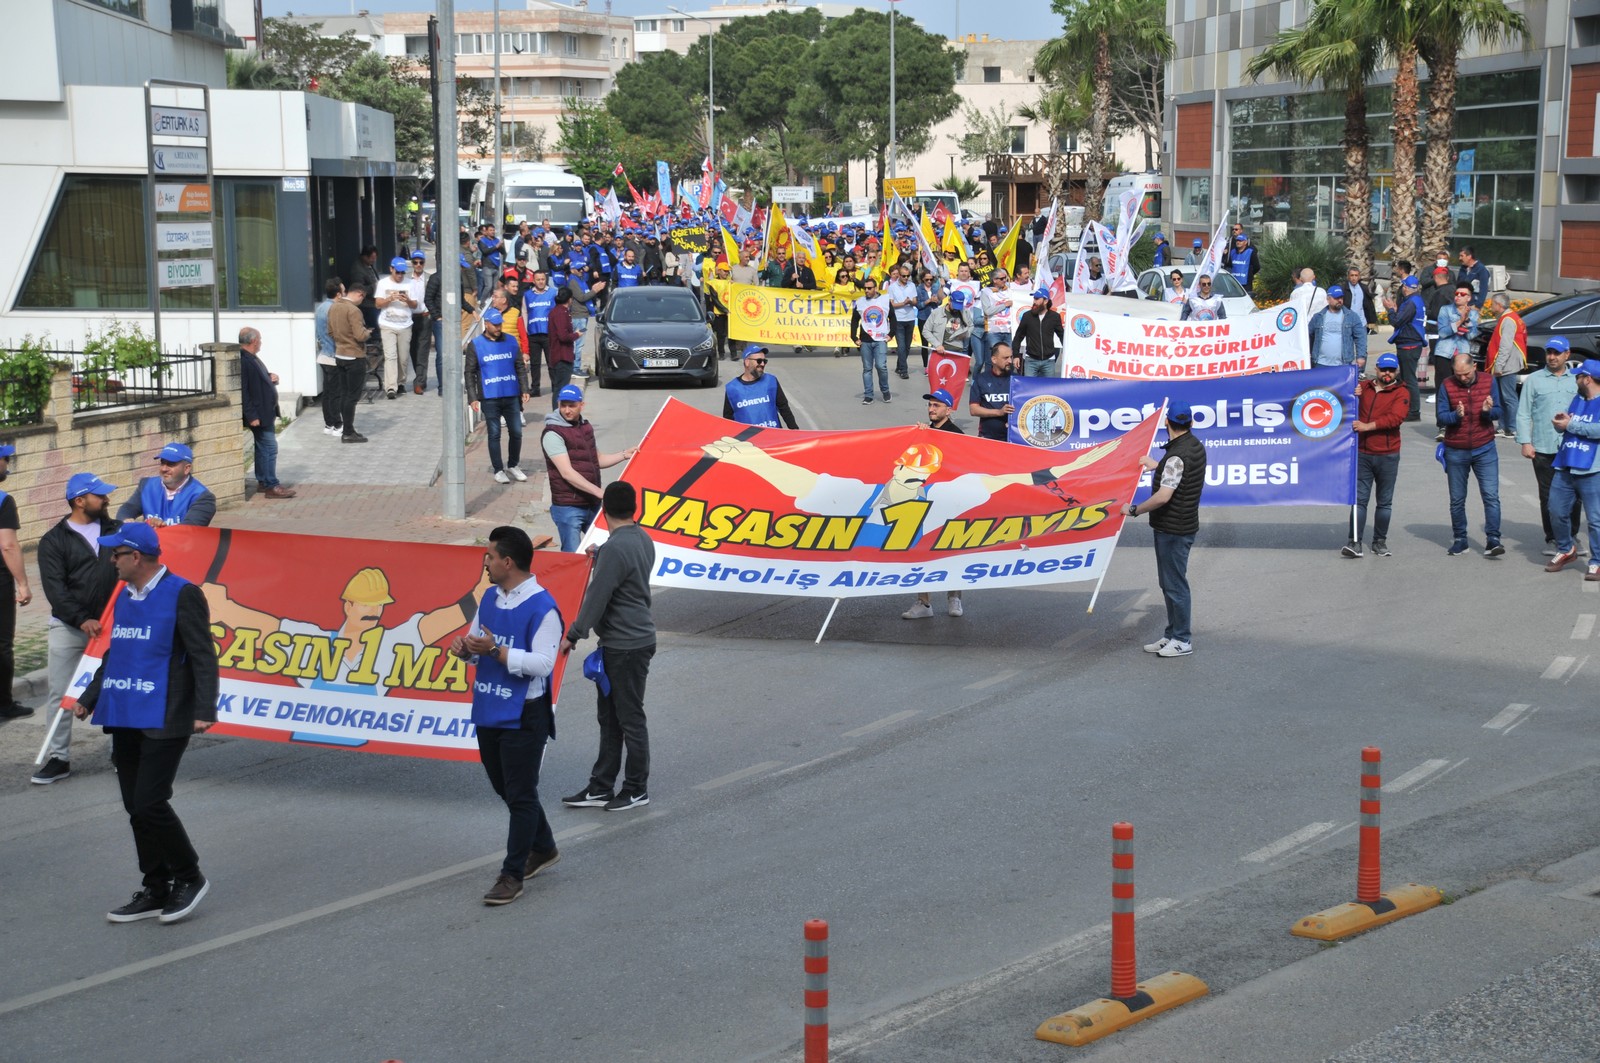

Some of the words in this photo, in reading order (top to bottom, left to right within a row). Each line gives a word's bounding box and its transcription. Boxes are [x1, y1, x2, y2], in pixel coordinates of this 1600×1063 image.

[168, 262, 202, 278] BİYODEM
[775, 316, 818, 328] ALİAĞA
[820, 319, 851, 328] TEMS
[1142, 324, 1230, 342] YAŞASIN
[1108, 355, 1259, 377] MÜCADELEMİZ
[737, 395, 770, 408] GÖREVLİ
[985, 394, 1009, 402] VEST
[1205, 438, 1242, 448] İŞÇİLERİ
[1244, 437, 1291, 446] SENDİKASI
[1205, 457, 1299, 486] UBESİ
[638, 488, 867, 551] YAŞASIN
[880, 498, 934, 551] 1
[930, 498, 1117, 551] MAYIS
[657, 556, 820, 590] petrol-iş
[828, 566, 949, 588] Aliağa
[961, 548, 1097, 584] Şubesi
[211, 624, 352, 683] ASIN
[346, 625, 385, 685] 1
[383, 643, 469, 693] MA
[474, 680, 513, 699] rol-iş
[243, 695, 272, 717] VE
[274, 701, 415, 733] DEMOKRASİ
[417, 715, 477, 739] PLAT
